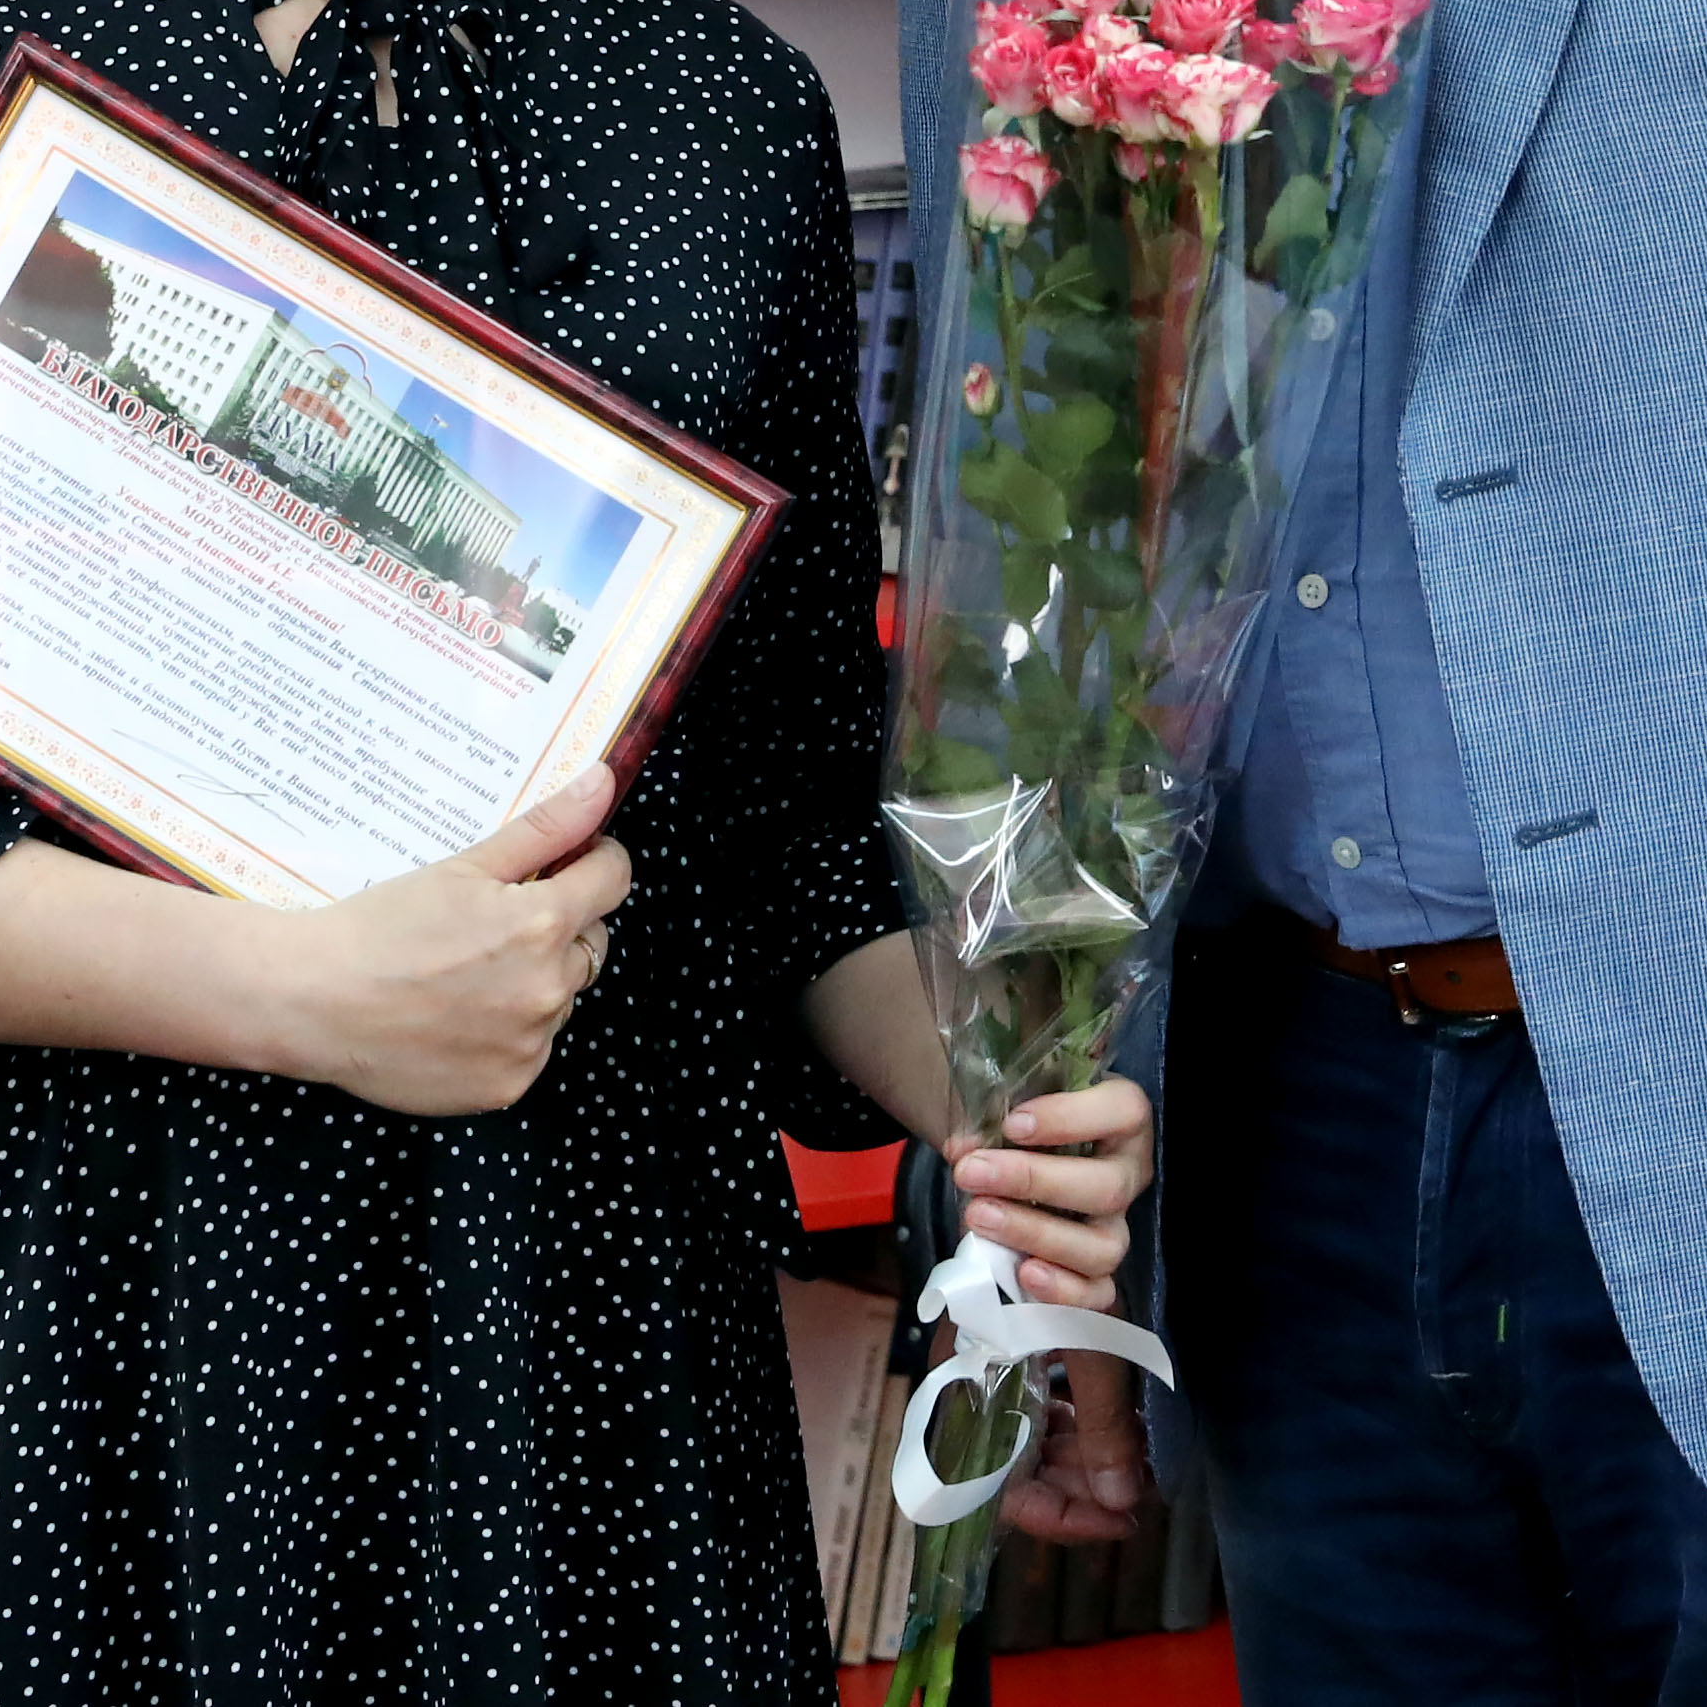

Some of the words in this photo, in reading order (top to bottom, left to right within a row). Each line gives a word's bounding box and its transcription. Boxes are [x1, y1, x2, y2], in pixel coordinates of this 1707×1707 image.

[24, 449, 93, 497] депутатов
[128, 514, 236, 586] Ставропольского
[265, 601, 328, 643] выражаю
[356, 658, 428, 706] искреннюю
[427, 701, 522, 764] благодарность
[36, 342, 368, 565] БЛАГОДАРСТВЕННОЕ
[360, 543, 509, 652] ПИСЬМО
[49, 485, 111, 525] развитие
[116, 525, 175, 565] системы
[180, 563, 262, 619] дошкольного
[266, 619, 345, 671] образования
[349, 669, 460, 743] Ставропольского
[115, 486, 192, 538] Уважаемая
[192, 534, 266, 585] Анастасия
[265, 580, 345, 633] Евгеньевна!
[181, 503, 272, 563] МОРОЗОВОЙ
[3, 544, 61, 583] познают
[59, 579, 146, 636] окружающий
[172, 651, 228, 687] радость
[360, 768, 478, 843] самостоятельной
[23, 539, 71, 572] именно
[159, 624, 211, 659] чутким
[214, 659, 304, 718] руководством
[353, 745, 429, 796] требующие
[434, 796, 484, 830] особого
[27, 576, 93, 620] основания
[188, 678, 239, 713] впереди
[349, 779, 466, 855] профессиональны
[80, 663, 144, 706] приносит
[141, 702, 197, 739] радость
[206, 742, 260, 779] хорошее
[259, 775, 340, 828] настроение!
[239, 638, 317, 688] творческий
[316, 686, 364, 718] подход
[414, 747, 501, 803] накопленный
